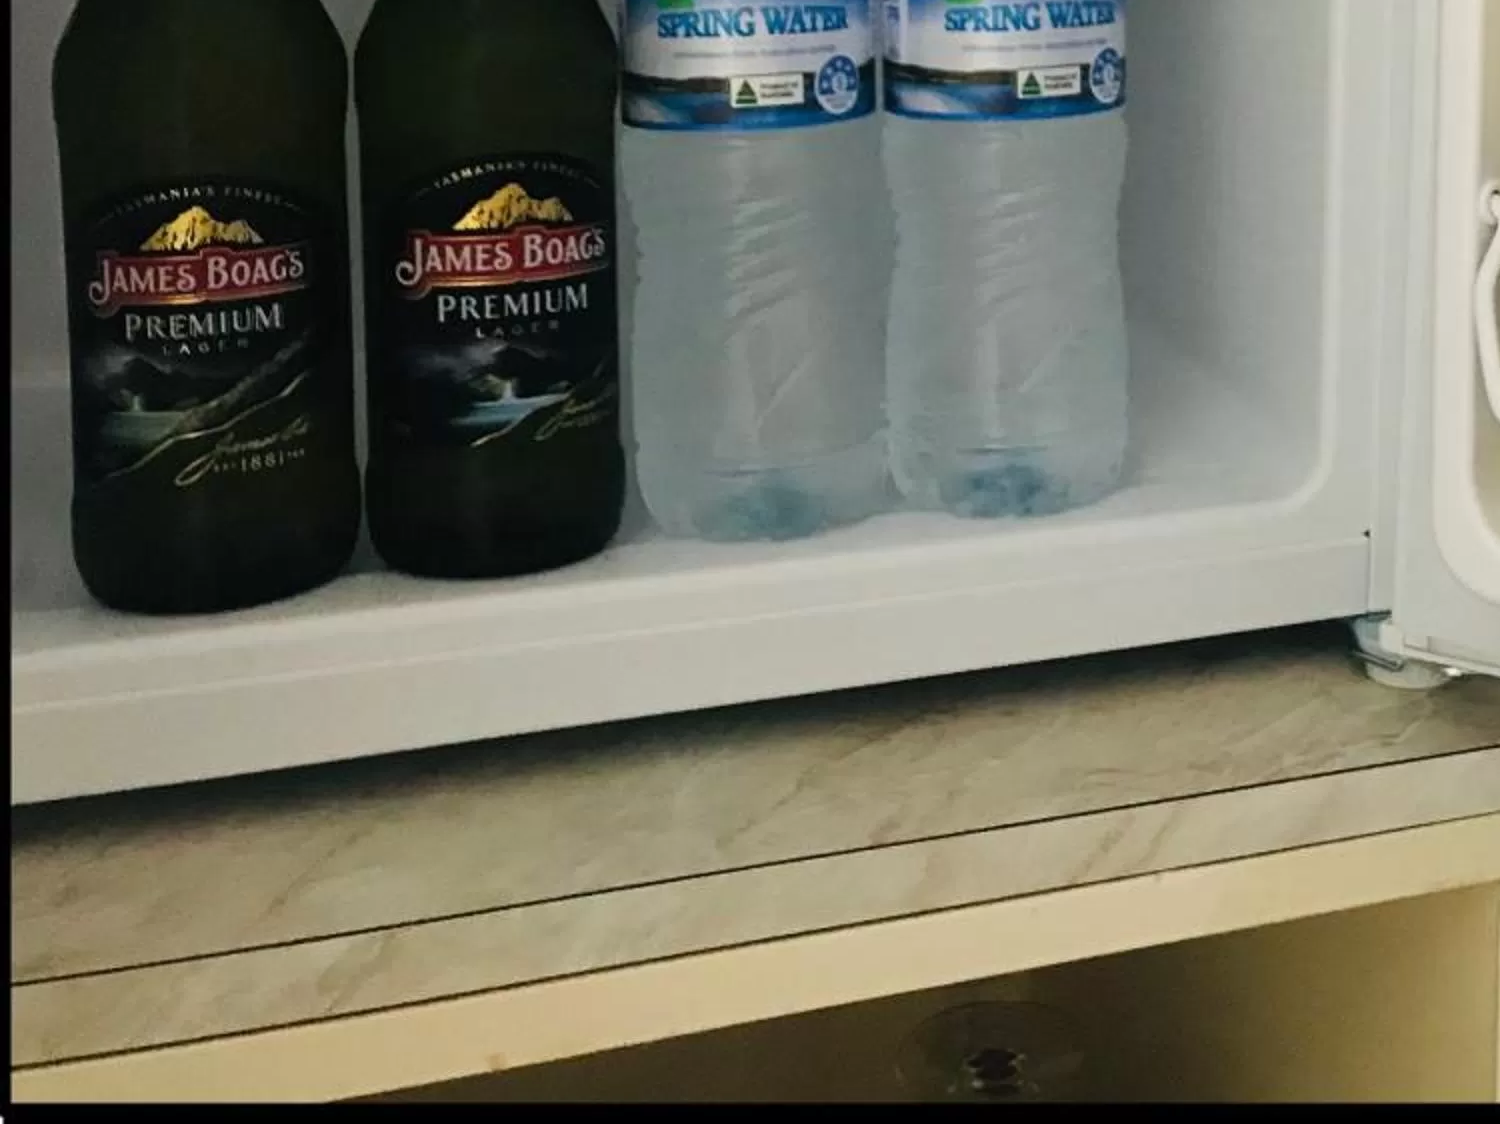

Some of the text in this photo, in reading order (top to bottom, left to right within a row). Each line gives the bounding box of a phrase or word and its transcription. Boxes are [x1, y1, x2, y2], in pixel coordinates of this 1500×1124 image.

[656, 4, 850, 39] SPRING WATER
[944, 0, 1117, 33] SPRING WATER
[88, 248, 305, 305] JAMES BOAG'S
[395, 227, 606, 286] JAMES BOAG'S
[124, 302, 283, 343] PREMIUM
[436, 282, 589, 324] PREMIUM
